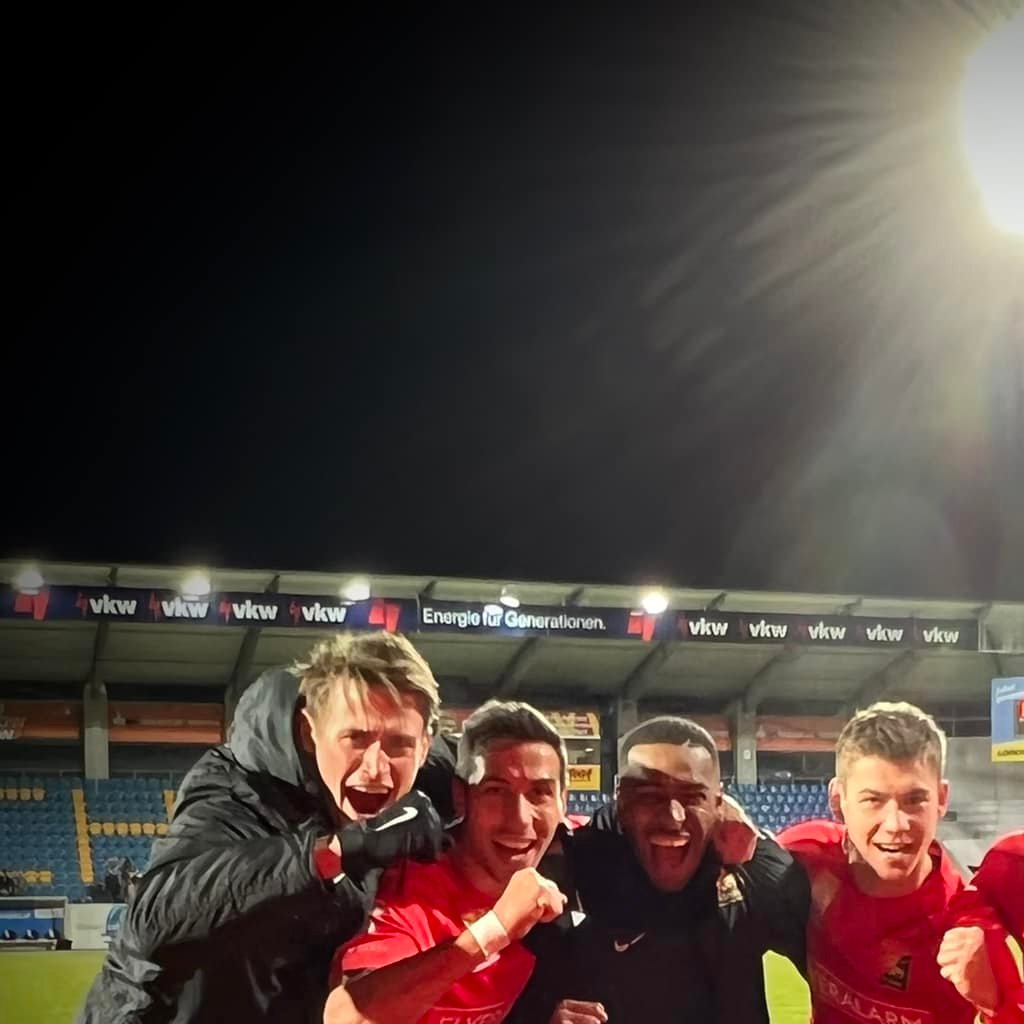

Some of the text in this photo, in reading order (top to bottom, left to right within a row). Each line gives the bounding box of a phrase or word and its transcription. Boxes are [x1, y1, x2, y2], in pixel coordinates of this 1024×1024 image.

[89, 594, 347, 623] vkw vkw vkw vkw
[423, 607, 480, 628] Energie
[688, 617, 960, 643] vkw vkw vkw vkw vkw
